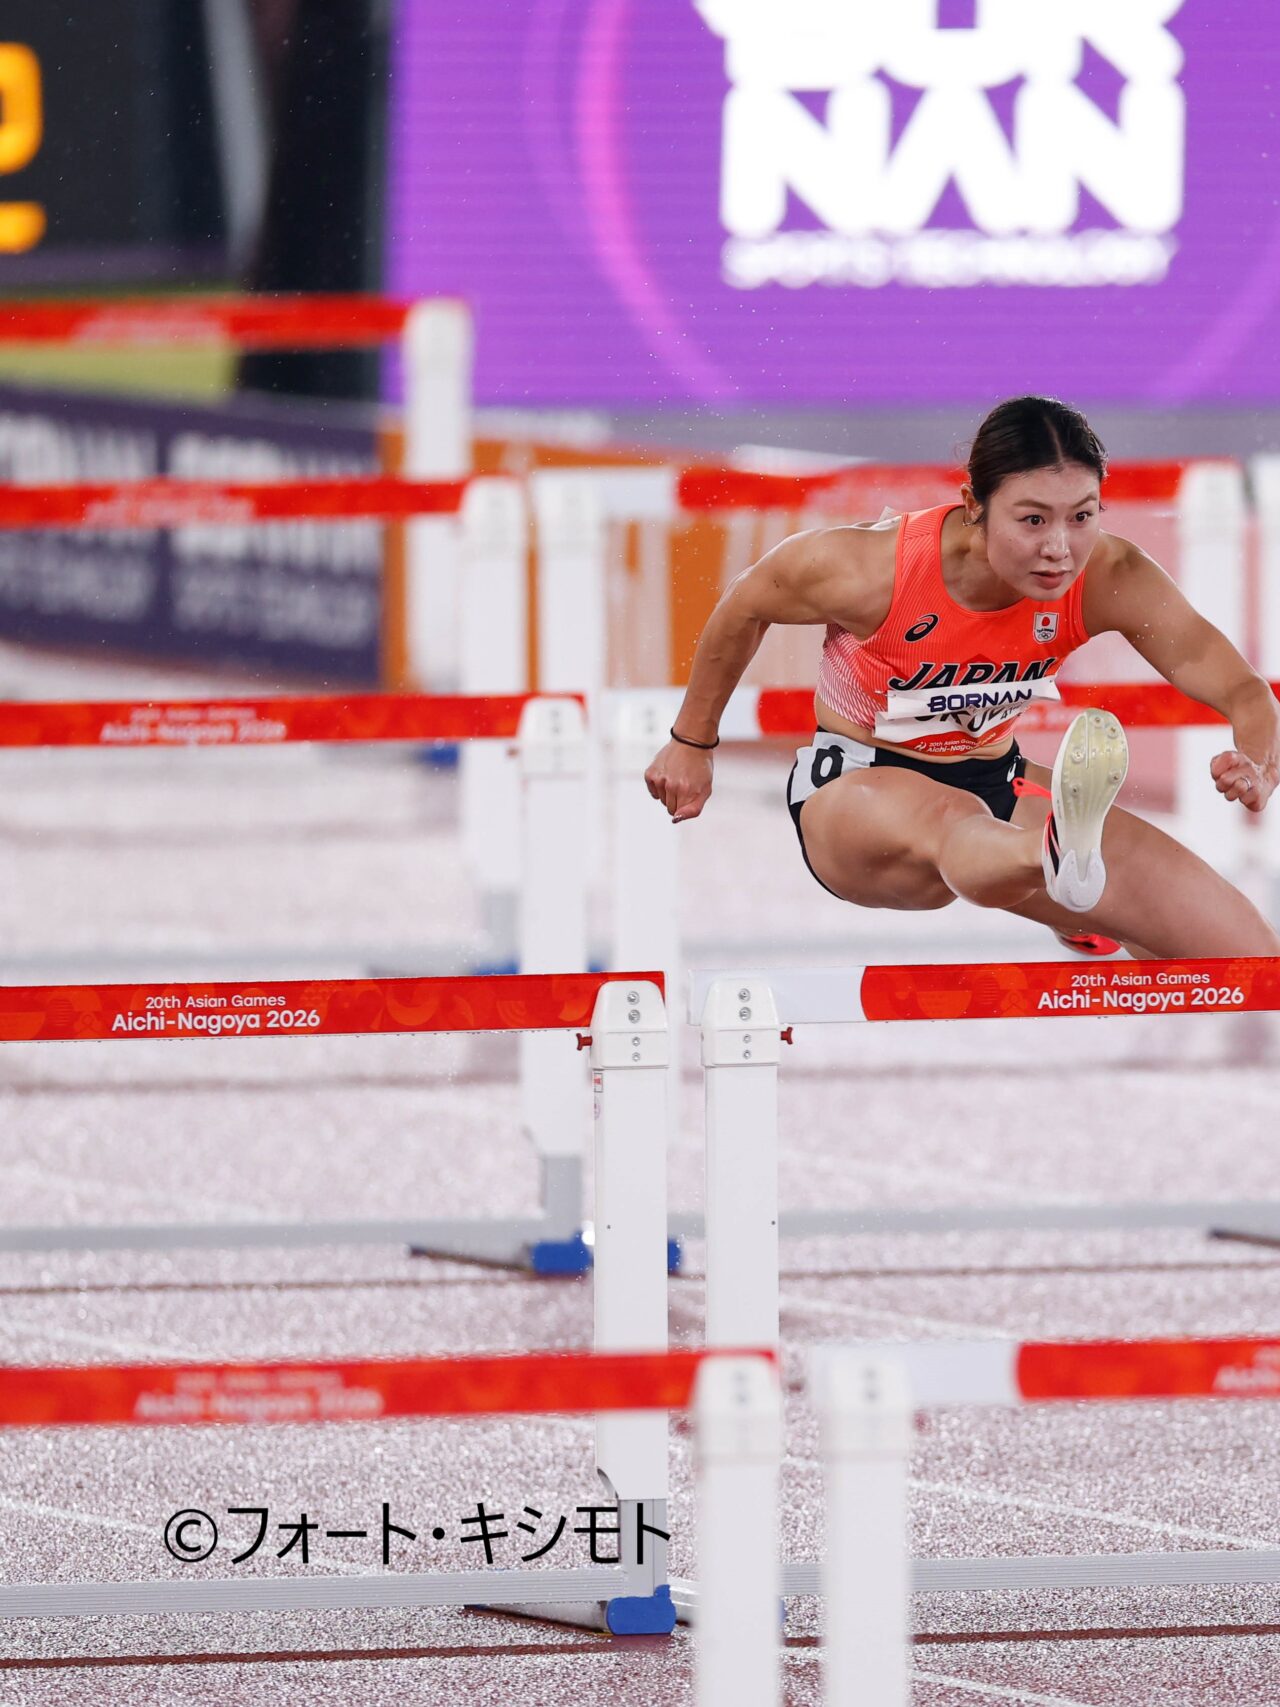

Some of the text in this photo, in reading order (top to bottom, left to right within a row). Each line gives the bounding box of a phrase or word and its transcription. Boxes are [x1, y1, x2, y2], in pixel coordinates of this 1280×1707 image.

[888, 657, 1056, 691] JAPAN
[927, 688, 1032, 713] BORNAN
[1071, 972, 1210, 987] 20th Asian Games
[145, 994, 286, 1009] 20th Asian Games
[1037, 987, 1245, 1012] Aichi-Nagoya 2026
[112, 1009, 320, 1035] Aichi-Nagoya 2026
